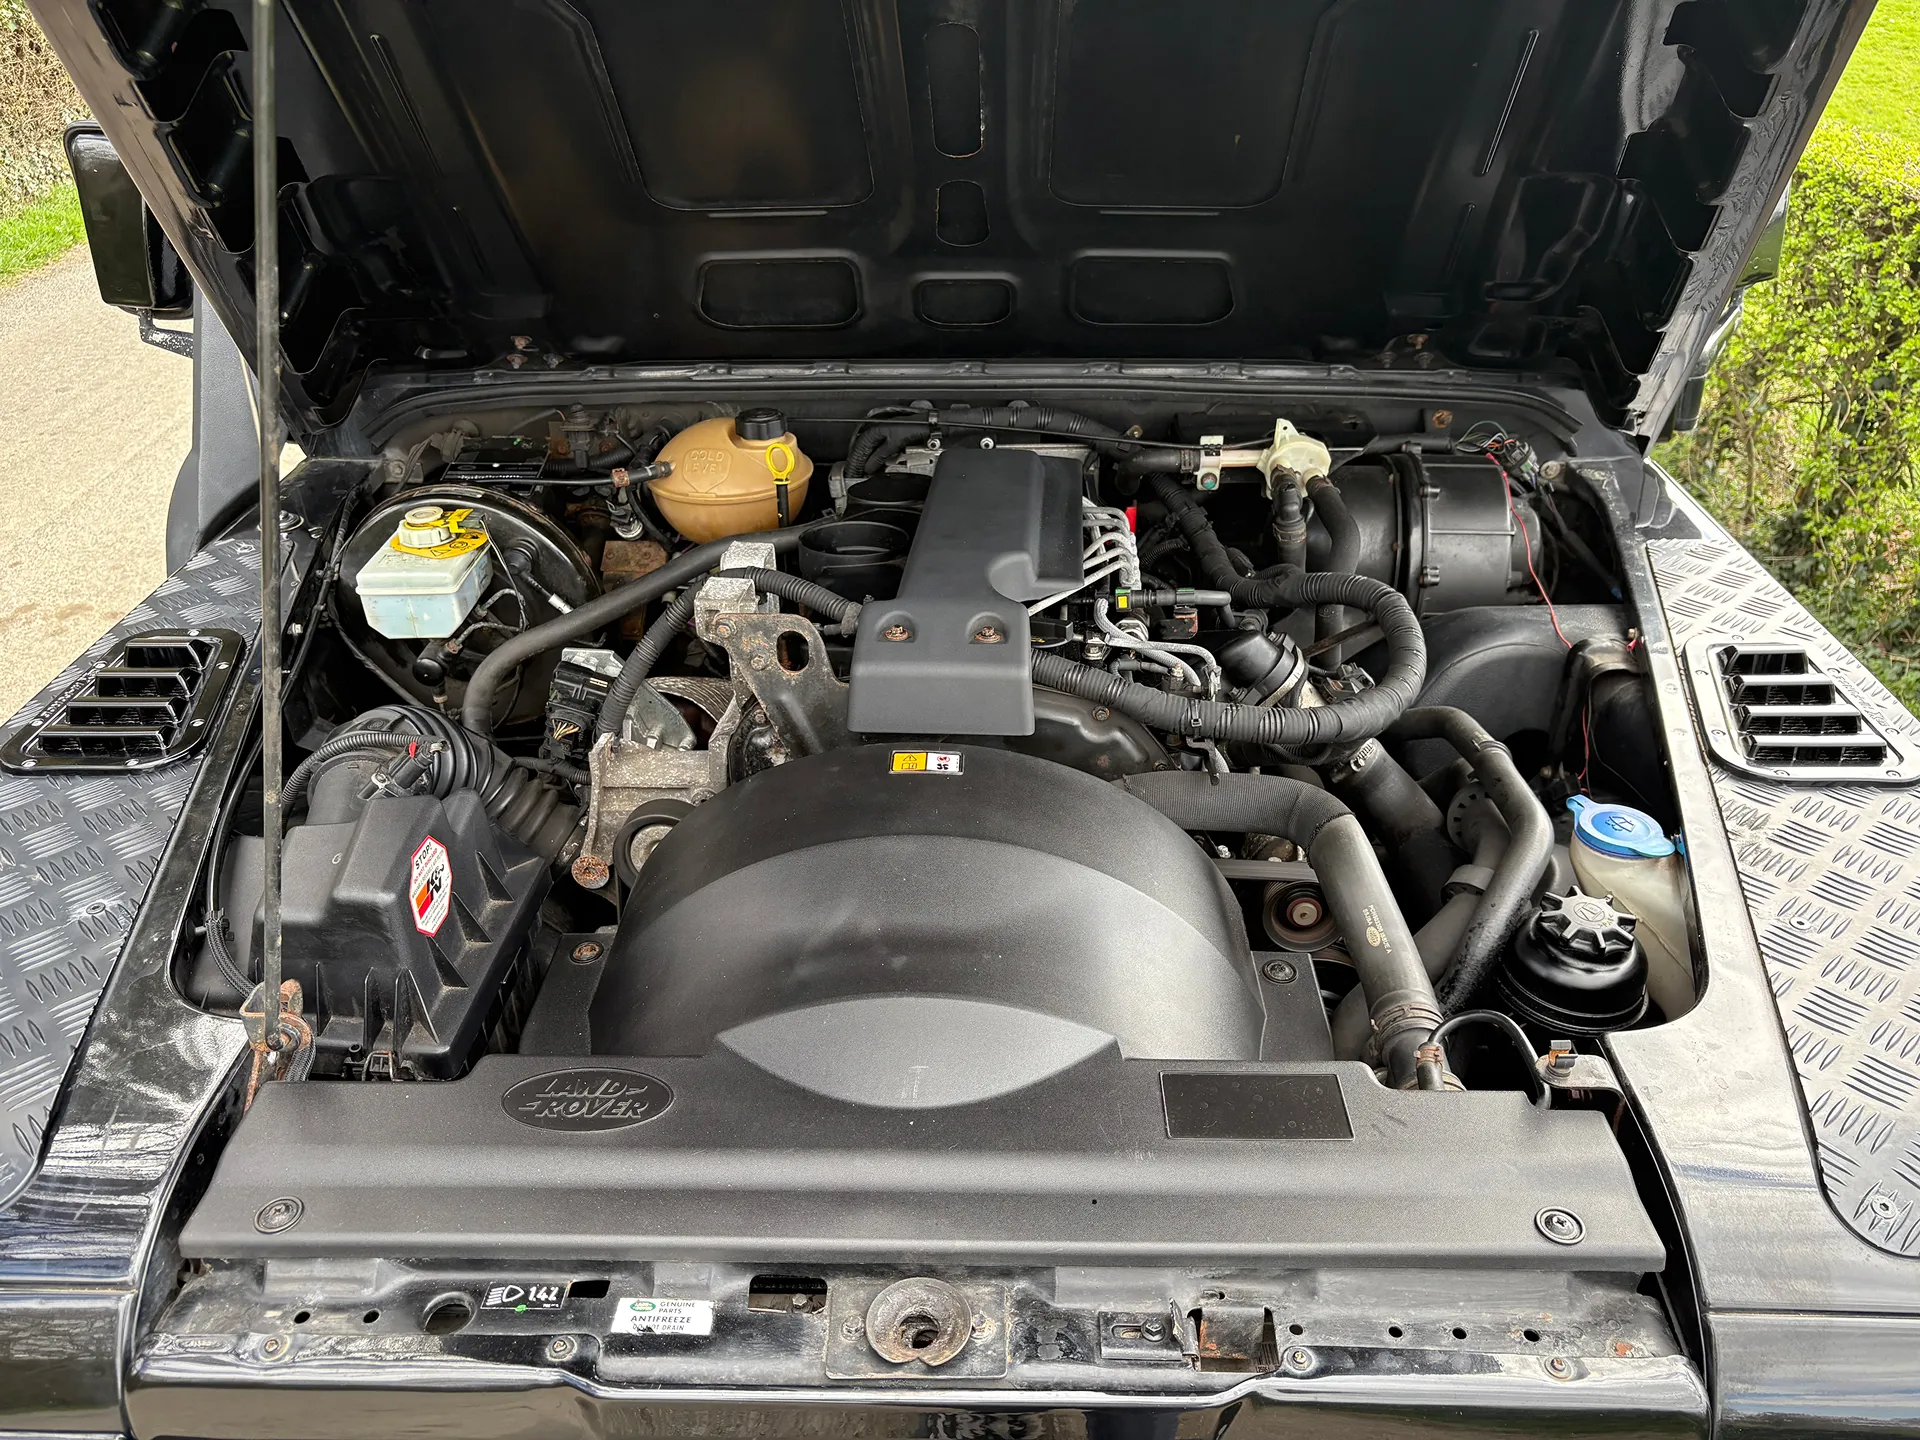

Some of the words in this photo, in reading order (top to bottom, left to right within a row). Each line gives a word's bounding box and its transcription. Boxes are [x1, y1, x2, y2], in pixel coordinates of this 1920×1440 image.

[691, 450, 724, 462] COLD
[415, 841, 433, 870] STOP!
[535, 1099, 651, 1119] ROVER
[630, 1315, 692, 1324] ANTIFREEZE
